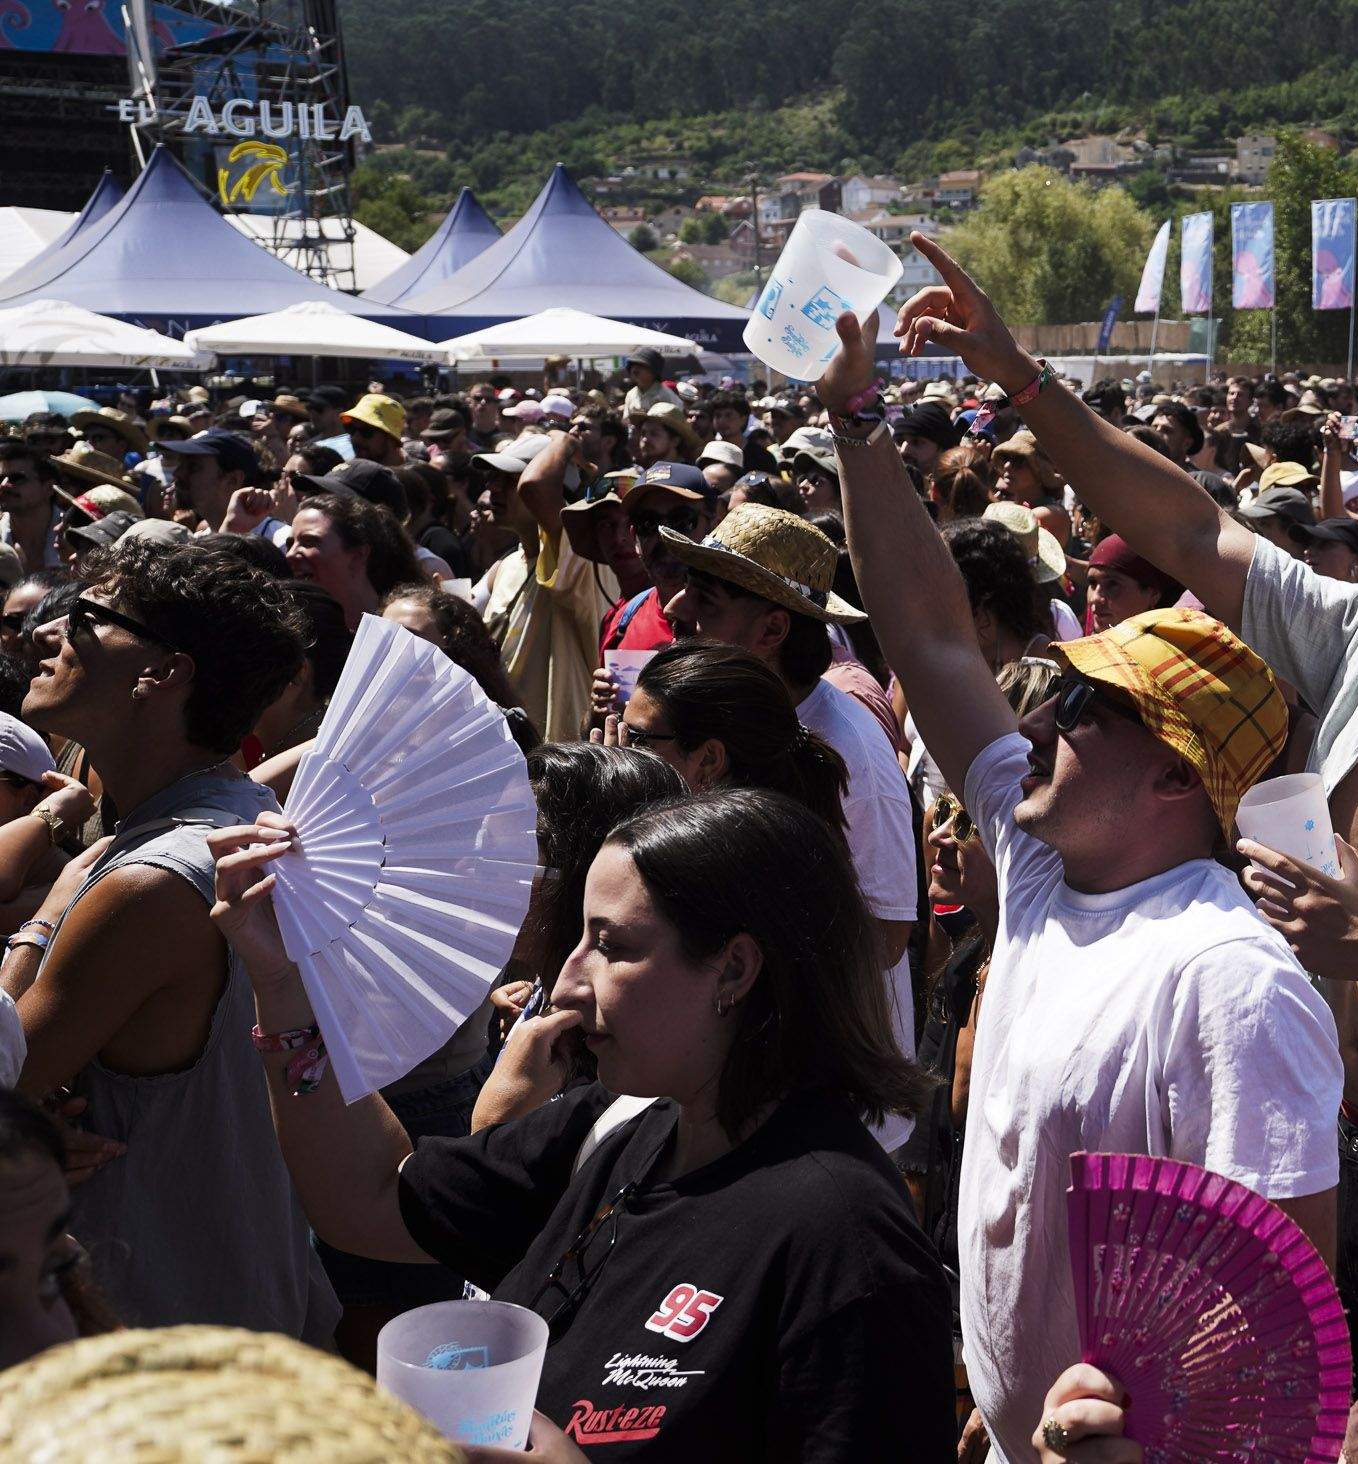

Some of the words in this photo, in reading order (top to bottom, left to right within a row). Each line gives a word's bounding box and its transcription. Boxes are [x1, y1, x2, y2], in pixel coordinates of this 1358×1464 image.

[119, 99, 157, 122] EL
[645, 1283, 724, 1343] 95
[604, 1353, 705, 1376] Lightning
[601, 1366, 687, 1390] McQueen
